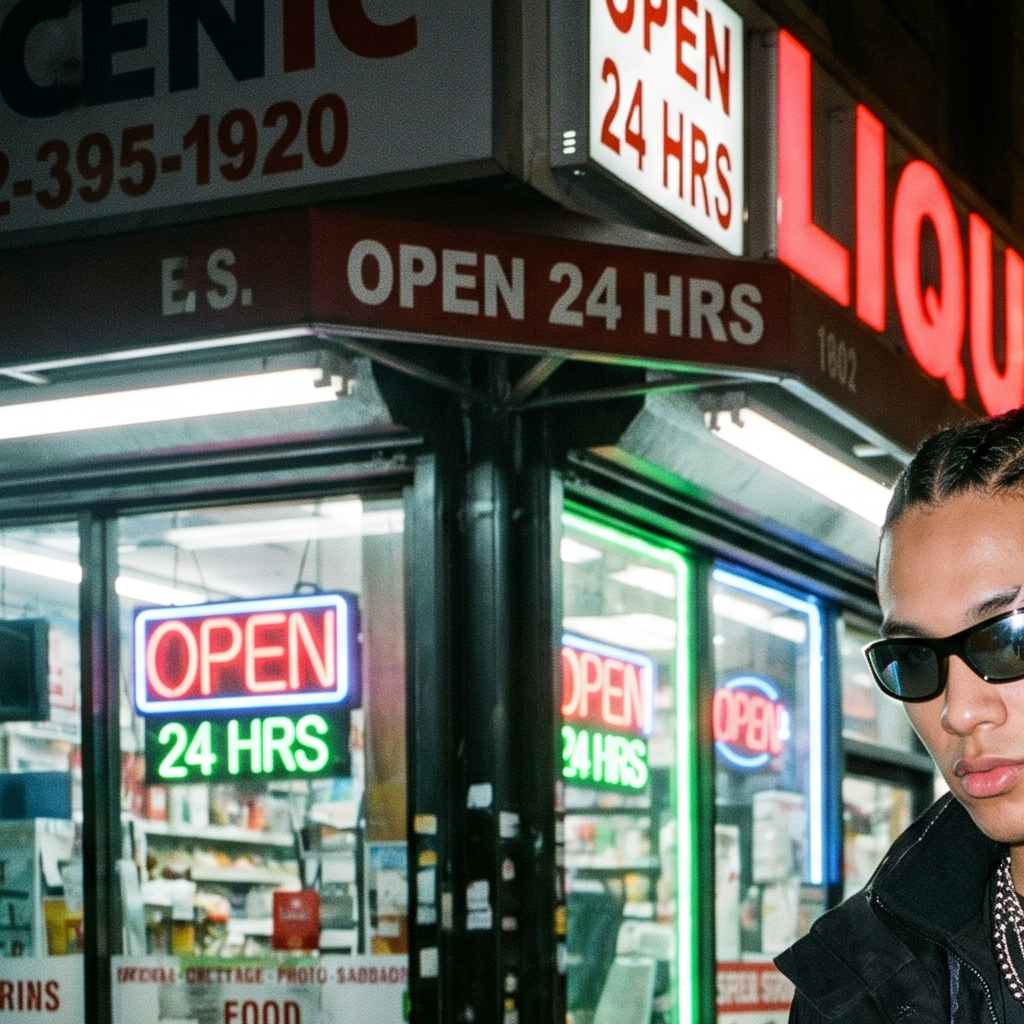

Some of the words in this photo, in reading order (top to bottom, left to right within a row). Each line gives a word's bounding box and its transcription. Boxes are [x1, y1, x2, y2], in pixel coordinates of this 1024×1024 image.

[0, 93, 349, 216] -395-1920
[600, 57, 647, 172] 24
[663, 99, 733, 231] HRS
[346, 239, 526, 320] OPEN
[548, 262, 622, 331] 24
[643, 271, 764, 345] HRS
[146, 609, 336, 699] OPEN
[157, 721, 217, 778] 24
[226, 713, 330, 775] HRS
[592, 732, 649, 789] HRS
[712, 687, 786, 755] OPEN
